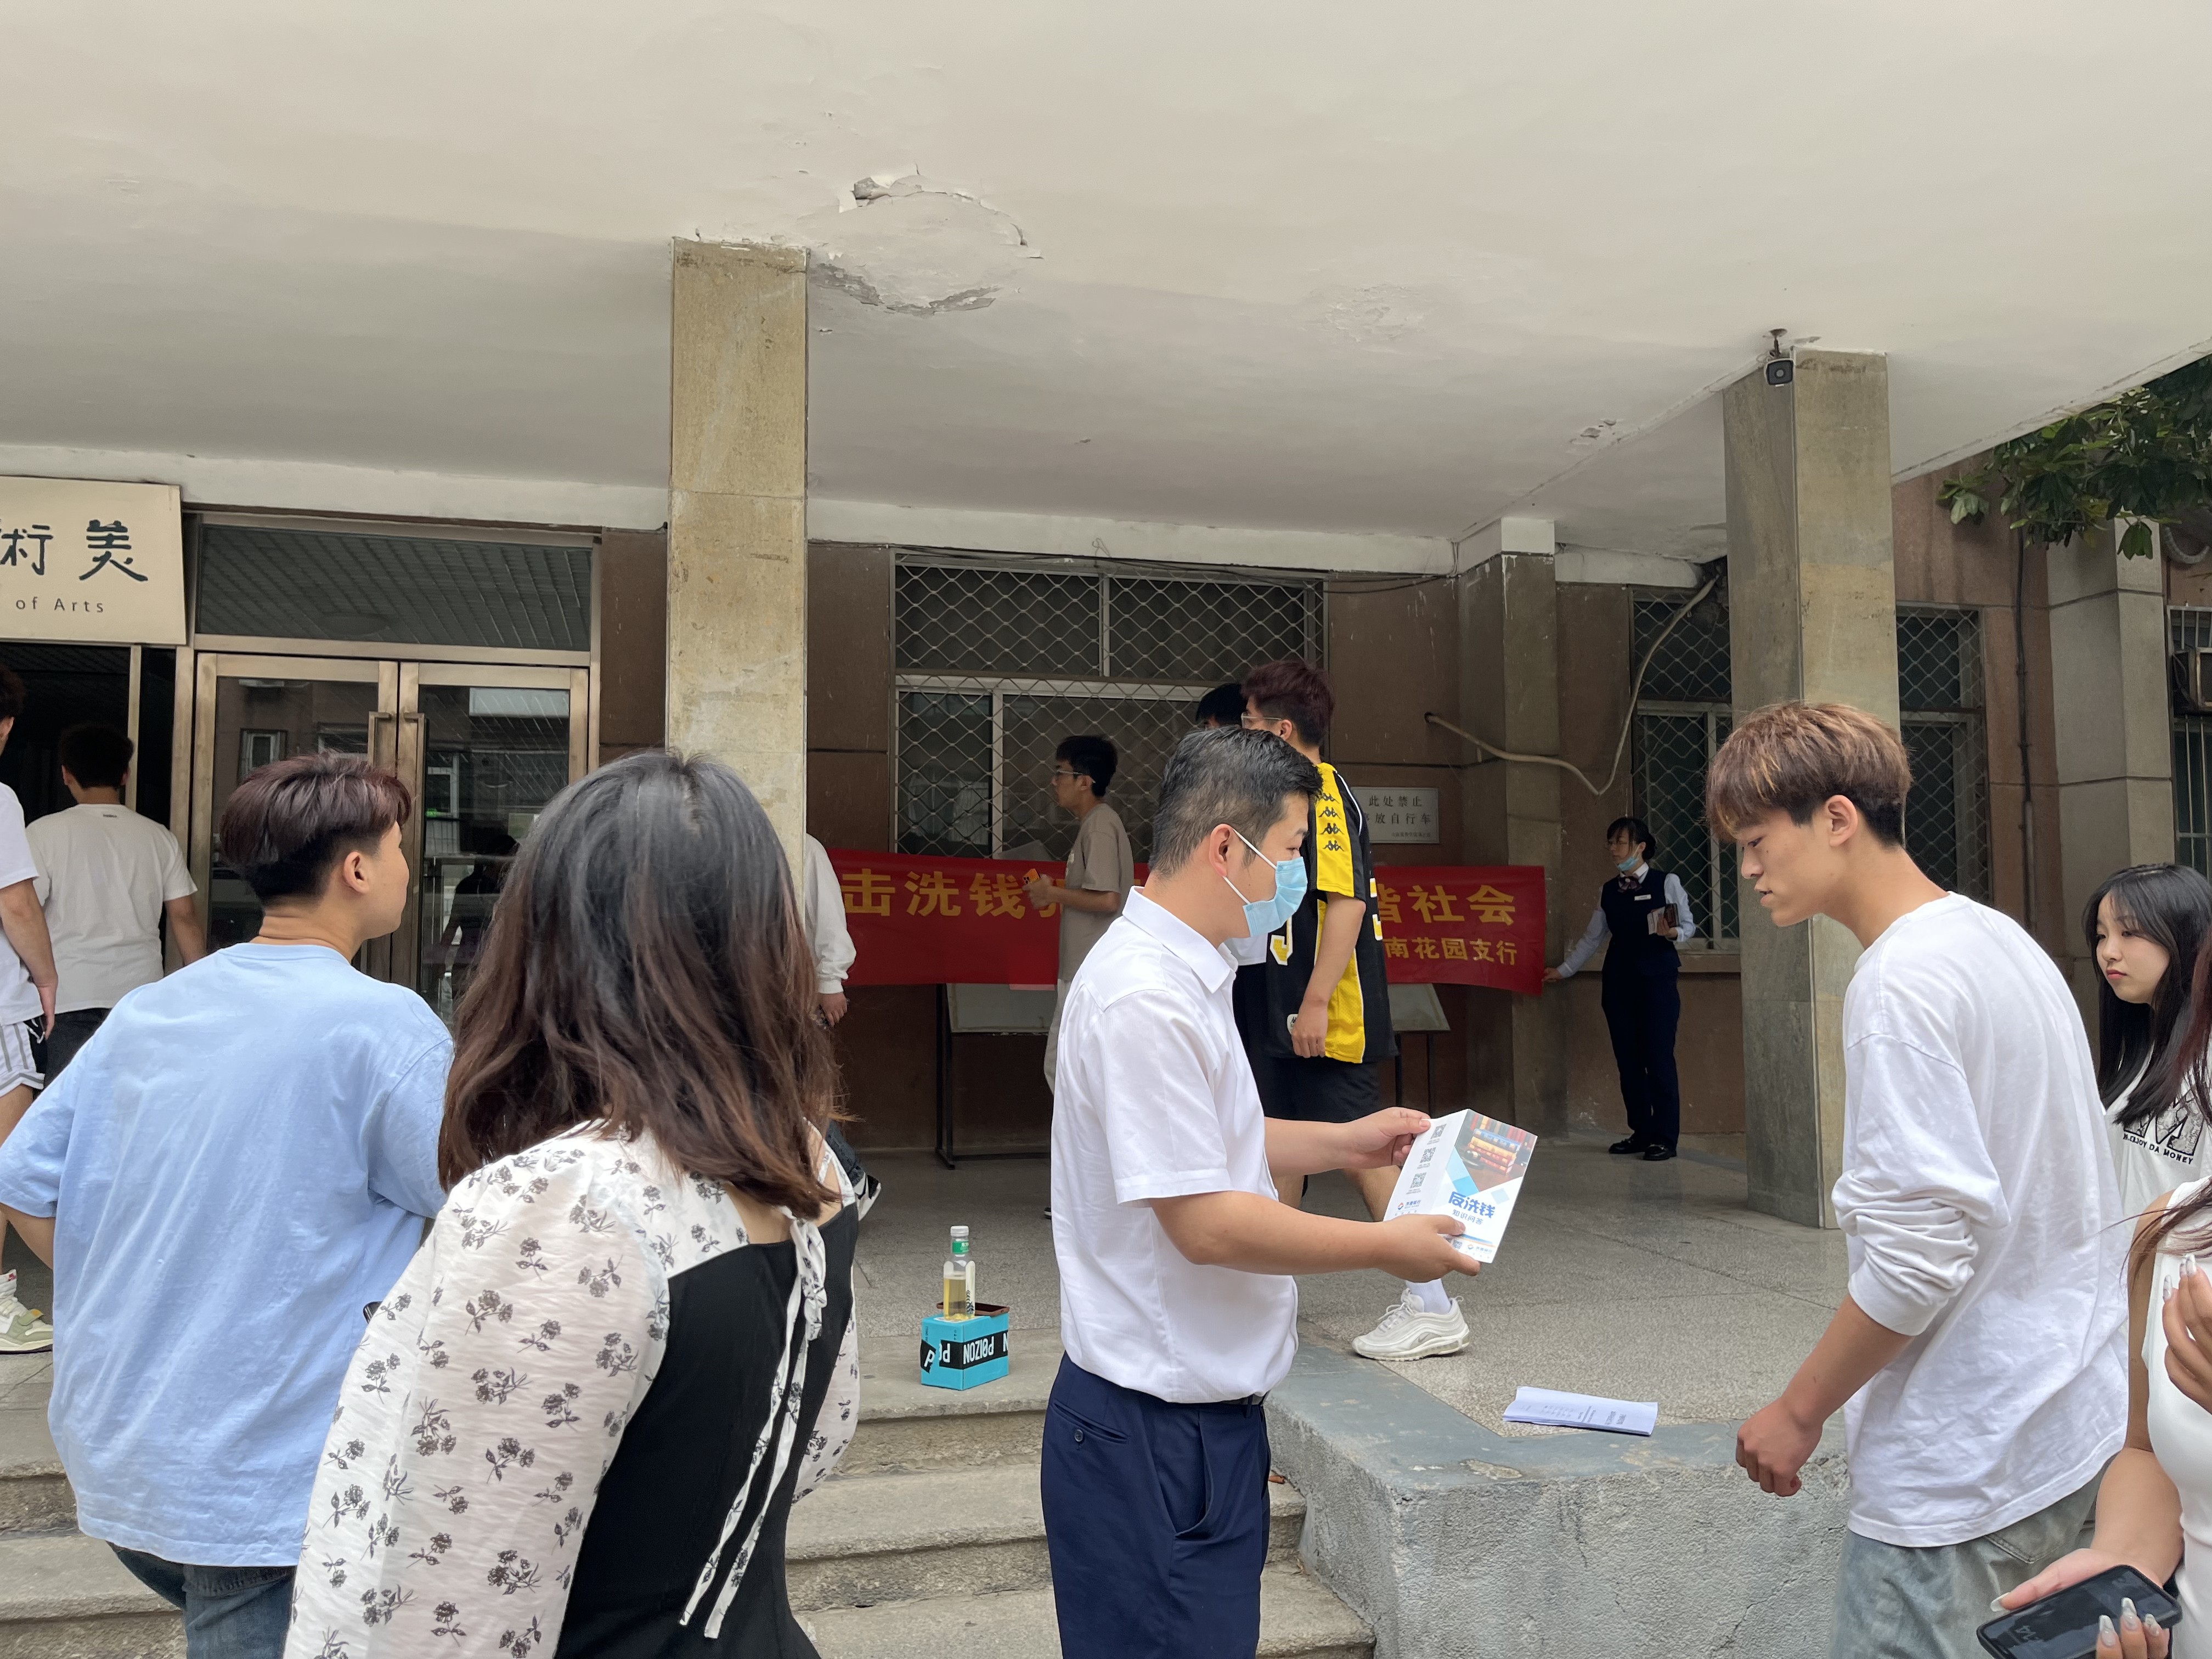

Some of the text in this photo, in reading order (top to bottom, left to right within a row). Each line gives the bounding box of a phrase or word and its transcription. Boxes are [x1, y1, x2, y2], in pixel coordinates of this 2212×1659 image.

[16, 596, 103, 613] of Arts
[1369, 795, 1422, 807] 此处禁止
[841, 868, 1065, 919] 击洗钱
[1383, 936, 1517, 965] 南花园支行
[1448, 1192, 1496, 1218] 反洗钱
[1452, 1209, 1483, 1224] 知识问答
